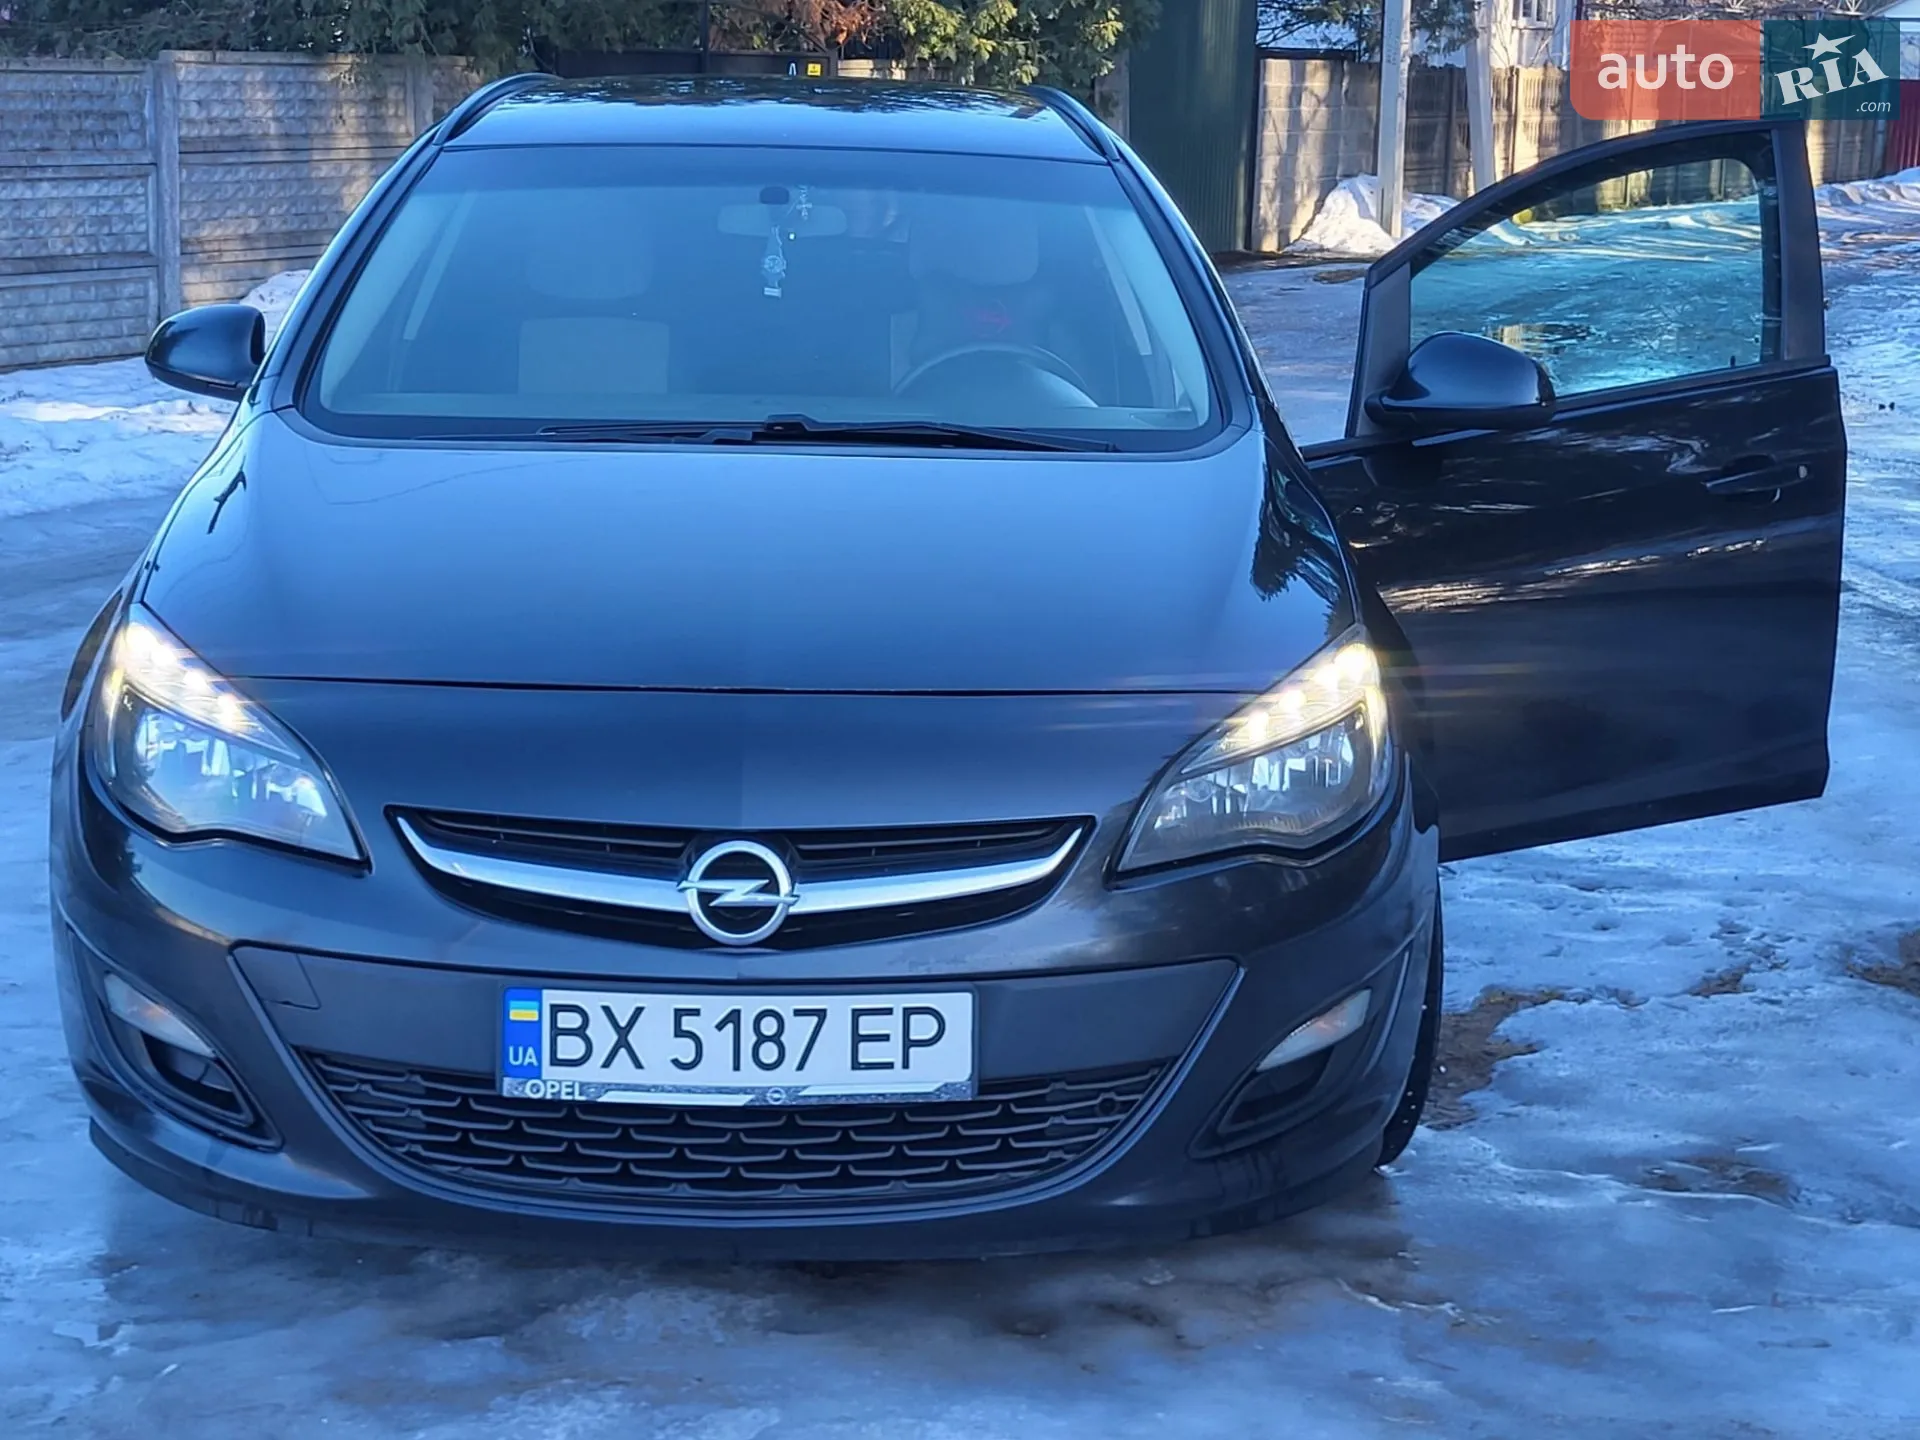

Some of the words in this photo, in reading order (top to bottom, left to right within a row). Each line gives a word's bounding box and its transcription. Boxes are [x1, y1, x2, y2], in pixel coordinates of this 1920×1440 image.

[549, 1003, 645, 1070] BX
[670, 1008, 827, 1071] 5187
[851, 1006, 946, 1070] EP
[509, 1046, 538, 1066] UA
[525, 1079, 587, 1100] OPEL
